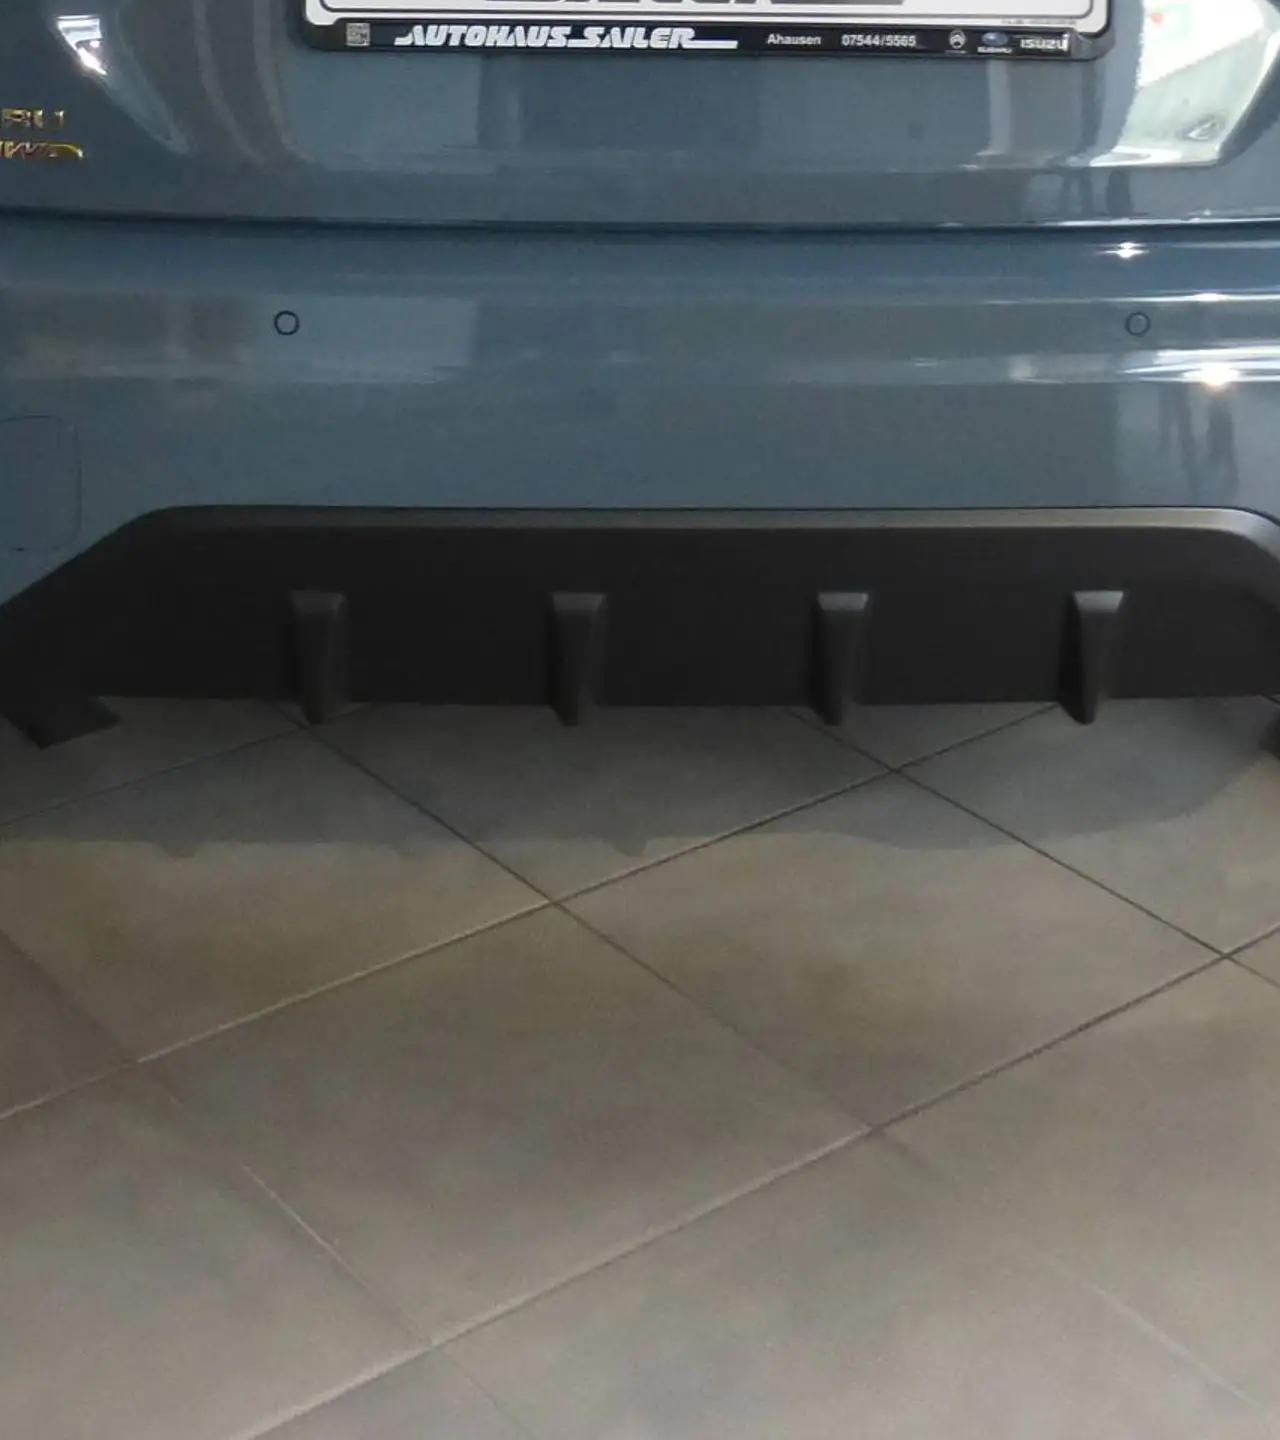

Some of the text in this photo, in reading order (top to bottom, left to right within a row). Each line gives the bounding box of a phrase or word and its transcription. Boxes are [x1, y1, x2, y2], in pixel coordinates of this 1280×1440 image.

[395, 25, 568, 47] AUTOHAUS
[568, 27, 738, 49] SAILER
[767, 34, 821, 46] Ahausen
